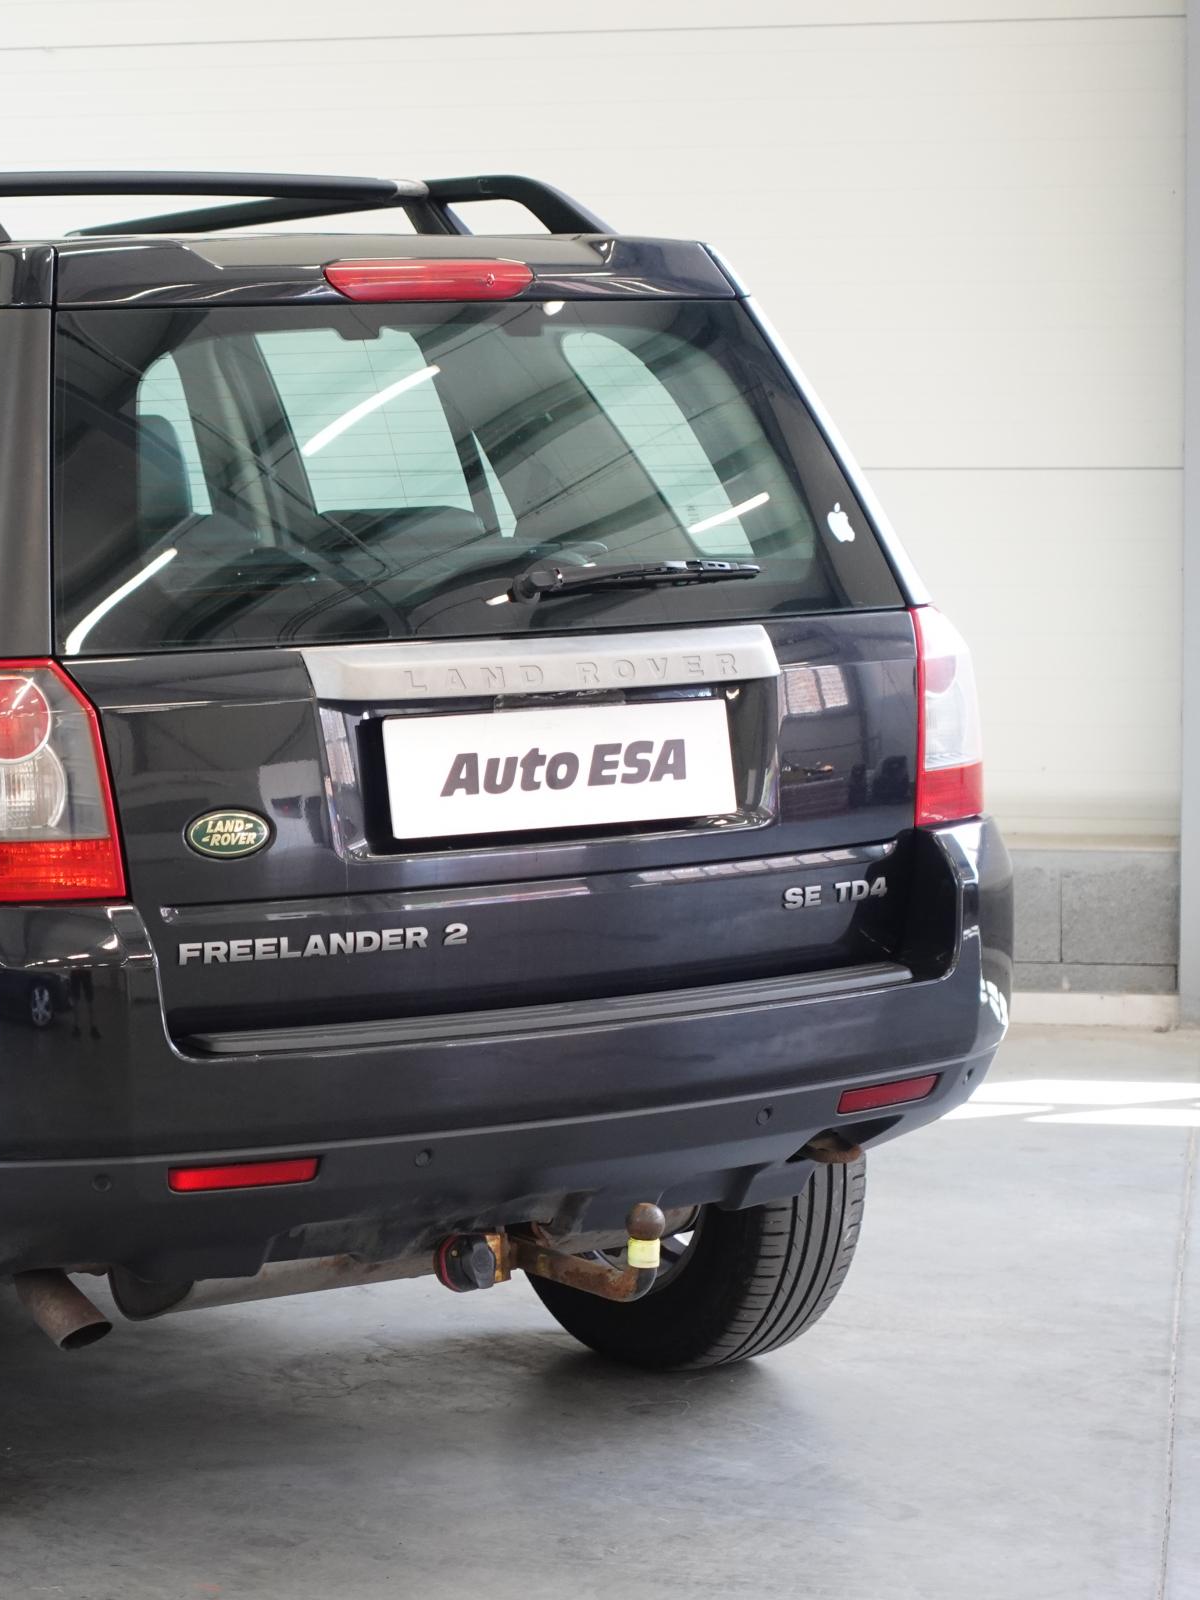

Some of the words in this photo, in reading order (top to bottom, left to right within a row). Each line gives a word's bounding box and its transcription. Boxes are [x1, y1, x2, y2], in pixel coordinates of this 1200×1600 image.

[403, 664, 545, 692] LAND
[576, 652, 738, 685] ROVER
[440, 747, 580, 798] Auto
[587, 738, 687, 787] ESA
[206, 819, 244, 834] LAND
[209, 831, 257, 847] ROVER
[783, 884, 822, 910] SE
[834, 876, 888, 903] TD4
[178, 926, 429, 966] FREELANDER
[443, 922, 469, 946] 2
